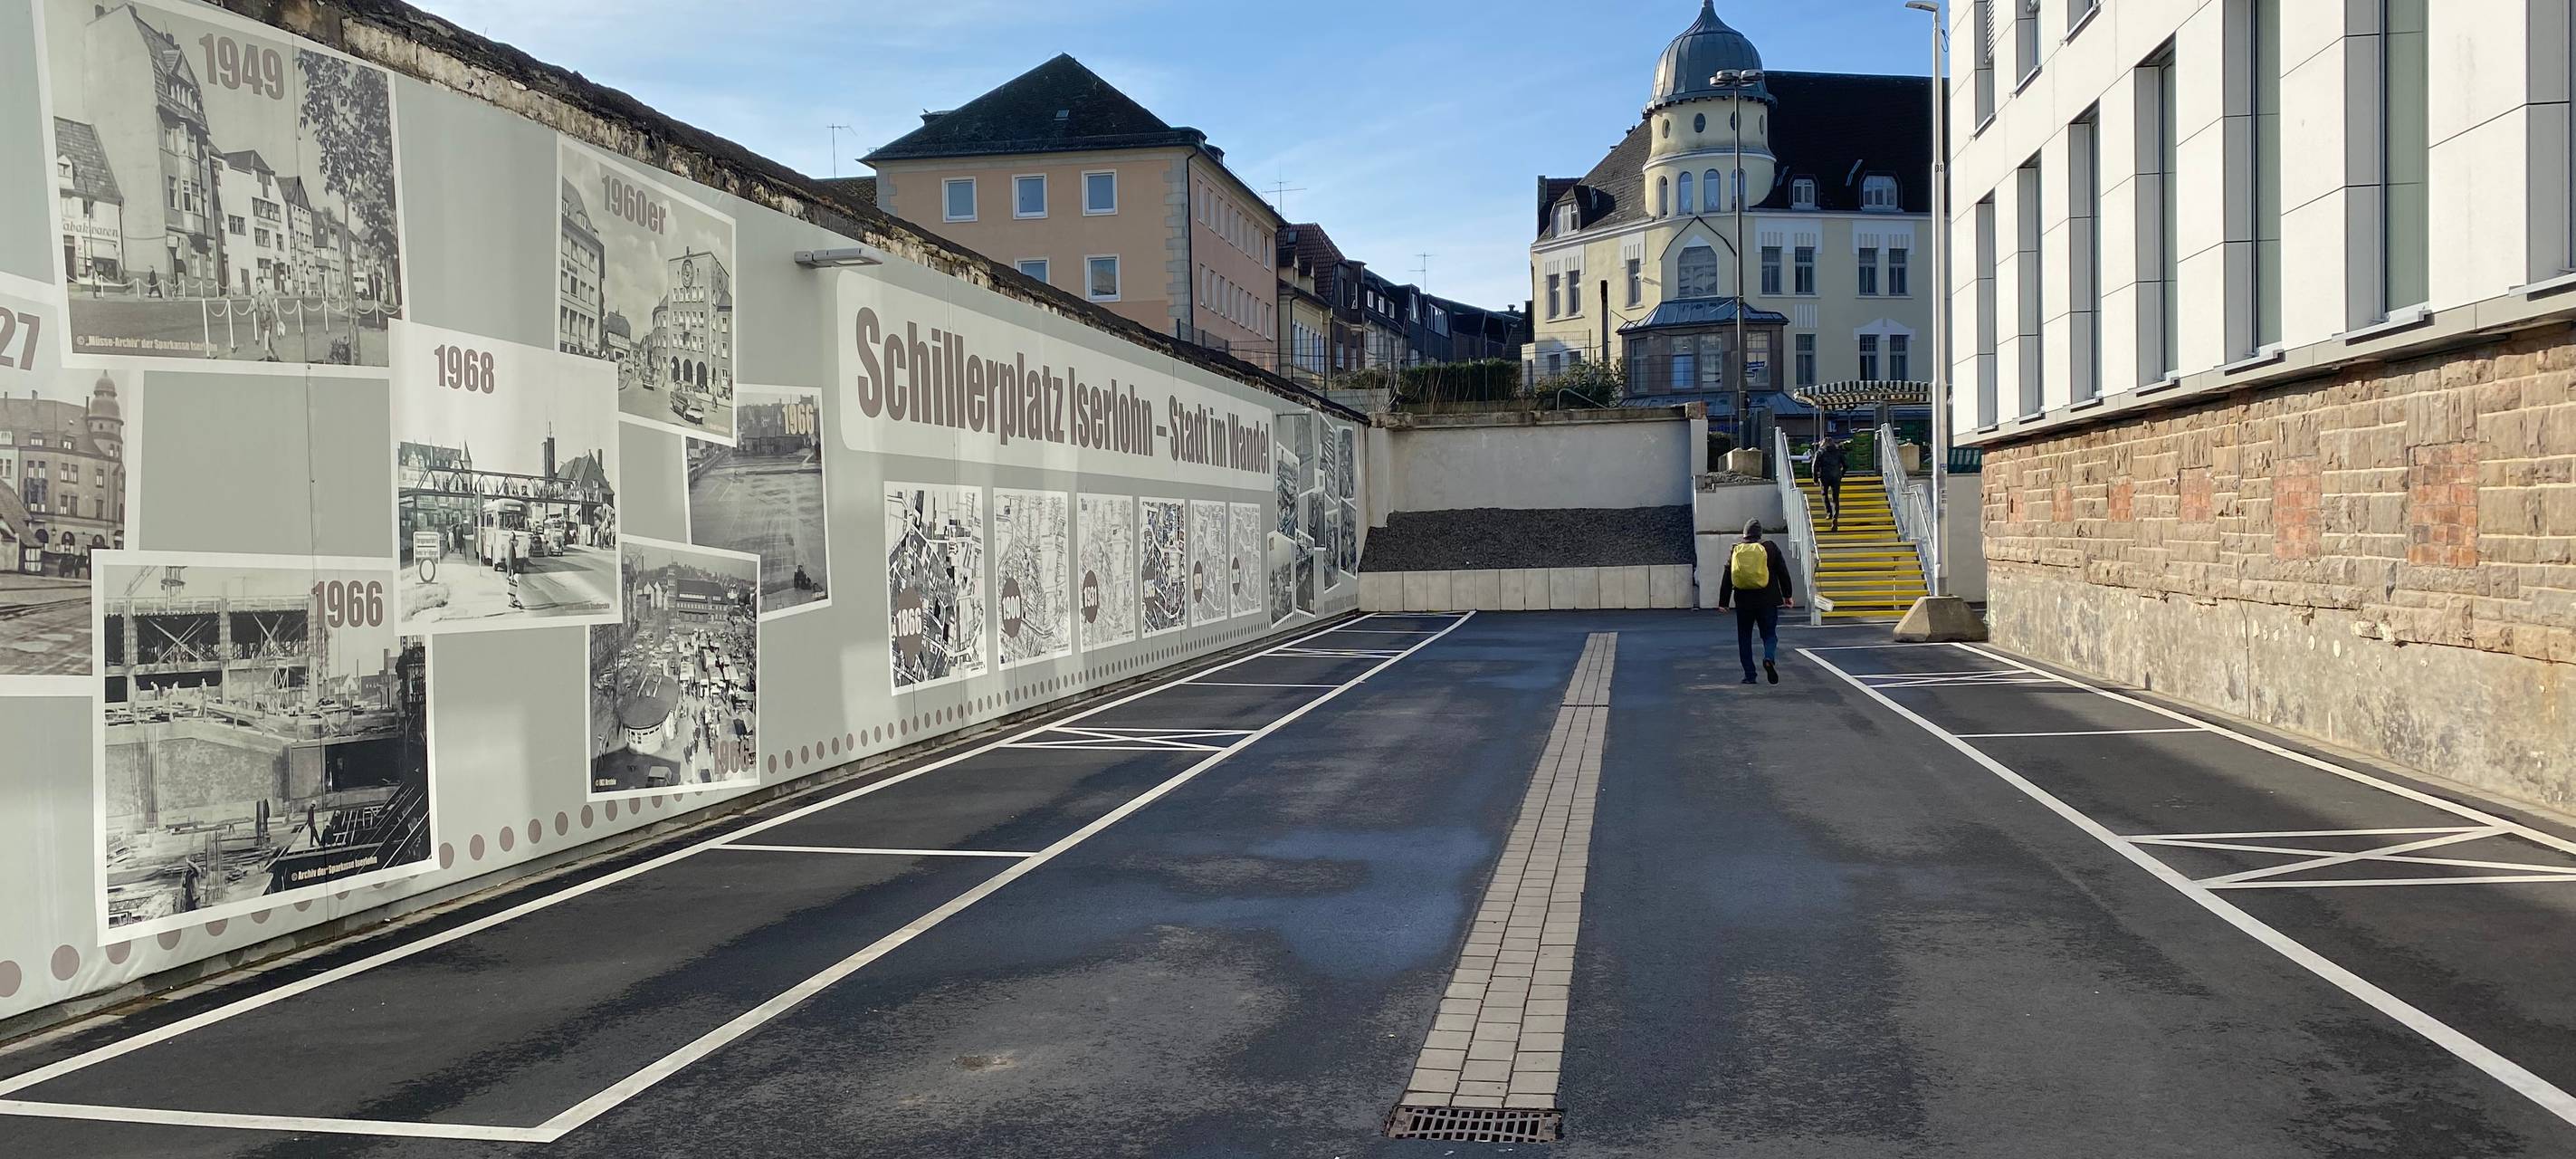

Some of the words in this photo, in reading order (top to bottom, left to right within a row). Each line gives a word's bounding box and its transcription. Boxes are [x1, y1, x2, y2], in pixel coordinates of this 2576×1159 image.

[199, 33, 285, 101] 1949
[601, 175, 666, 235] 1960er
[0, 307, 40, 370] 27
[141, 339, 154, 349] der
[154, 339, 190, 350] Sparkasse
[434, 343, 495, 395] 1968
[856, 306, 1064, 446] Schillerplatz
[1068, 367, 1153, 457] Iserlohn
[1168, 395, 1210, 465] Stadt
[1210, 407, 1226, 467] im
[1226, 413, 1271, 474] Wandel
[782, 404, 815, 435] 1966
[311, 580, 384, 629] 1966
[1002, 596, 1021, 620] 1900
[1083, 586, 1098, 608] 1931
[896, 608, 922, 637] 1866
[298, 868, 317, 880] Archiv
[317, 867, 328, 876] der
[328, 860, 355, 875] Sparkasse
